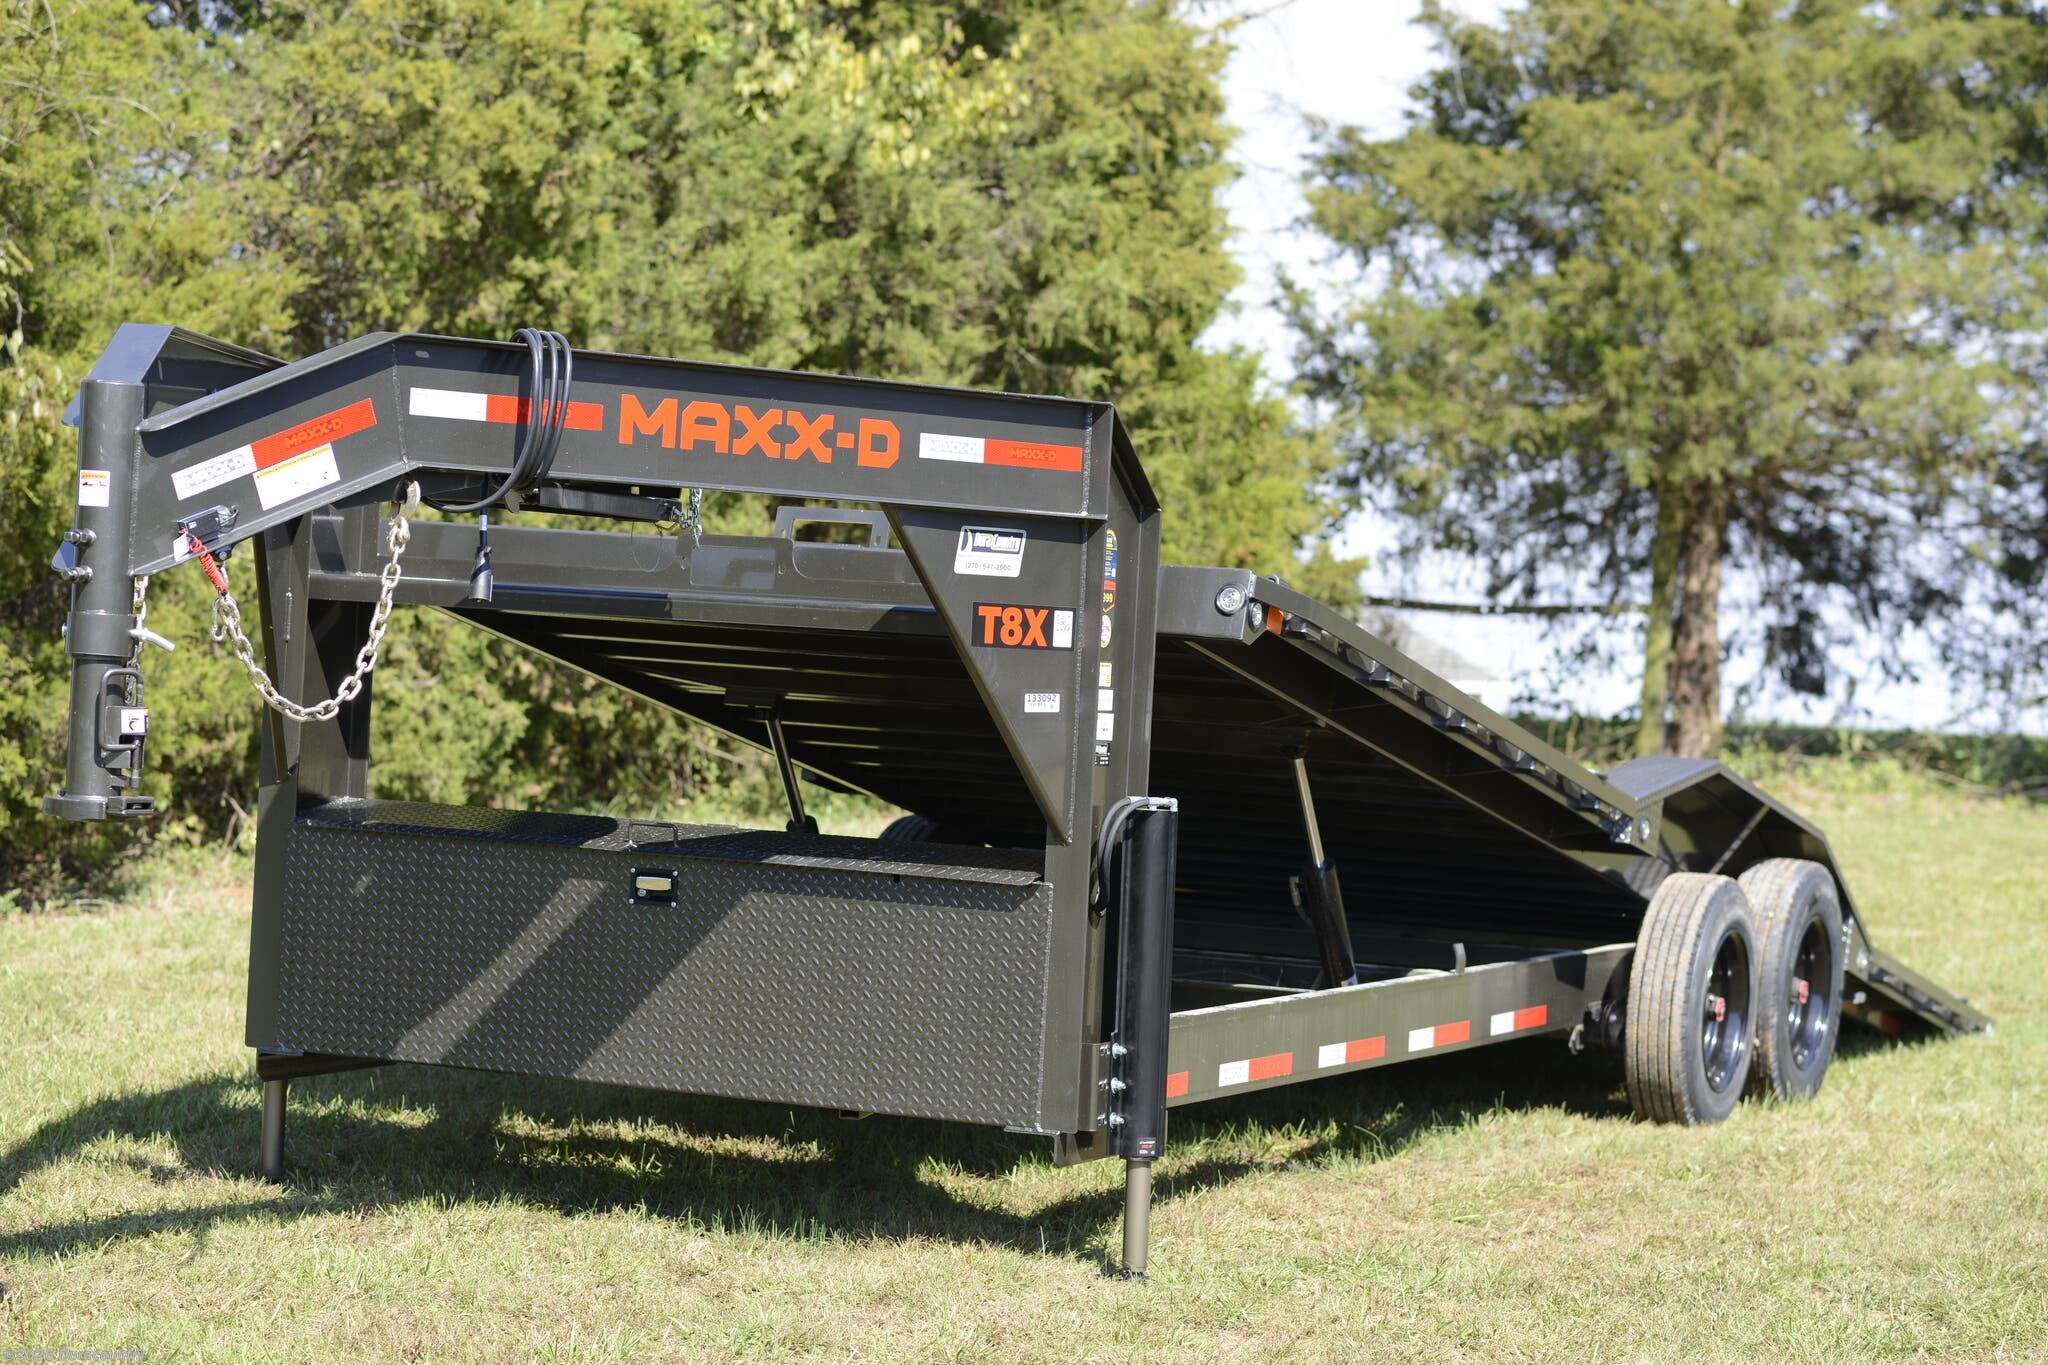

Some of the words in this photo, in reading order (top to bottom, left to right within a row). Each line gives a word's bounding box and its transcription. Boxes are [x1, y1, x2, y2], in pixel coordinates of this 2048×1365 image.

[285, 417, 343, 448] MAXX-D
[618, 393, 900, 469] MAXX-D
[1008, 447, 1056, 462] MAXX-D
[978, 605, 1049, 647] T8X
[1027, 694, 1057, 703] 133092
